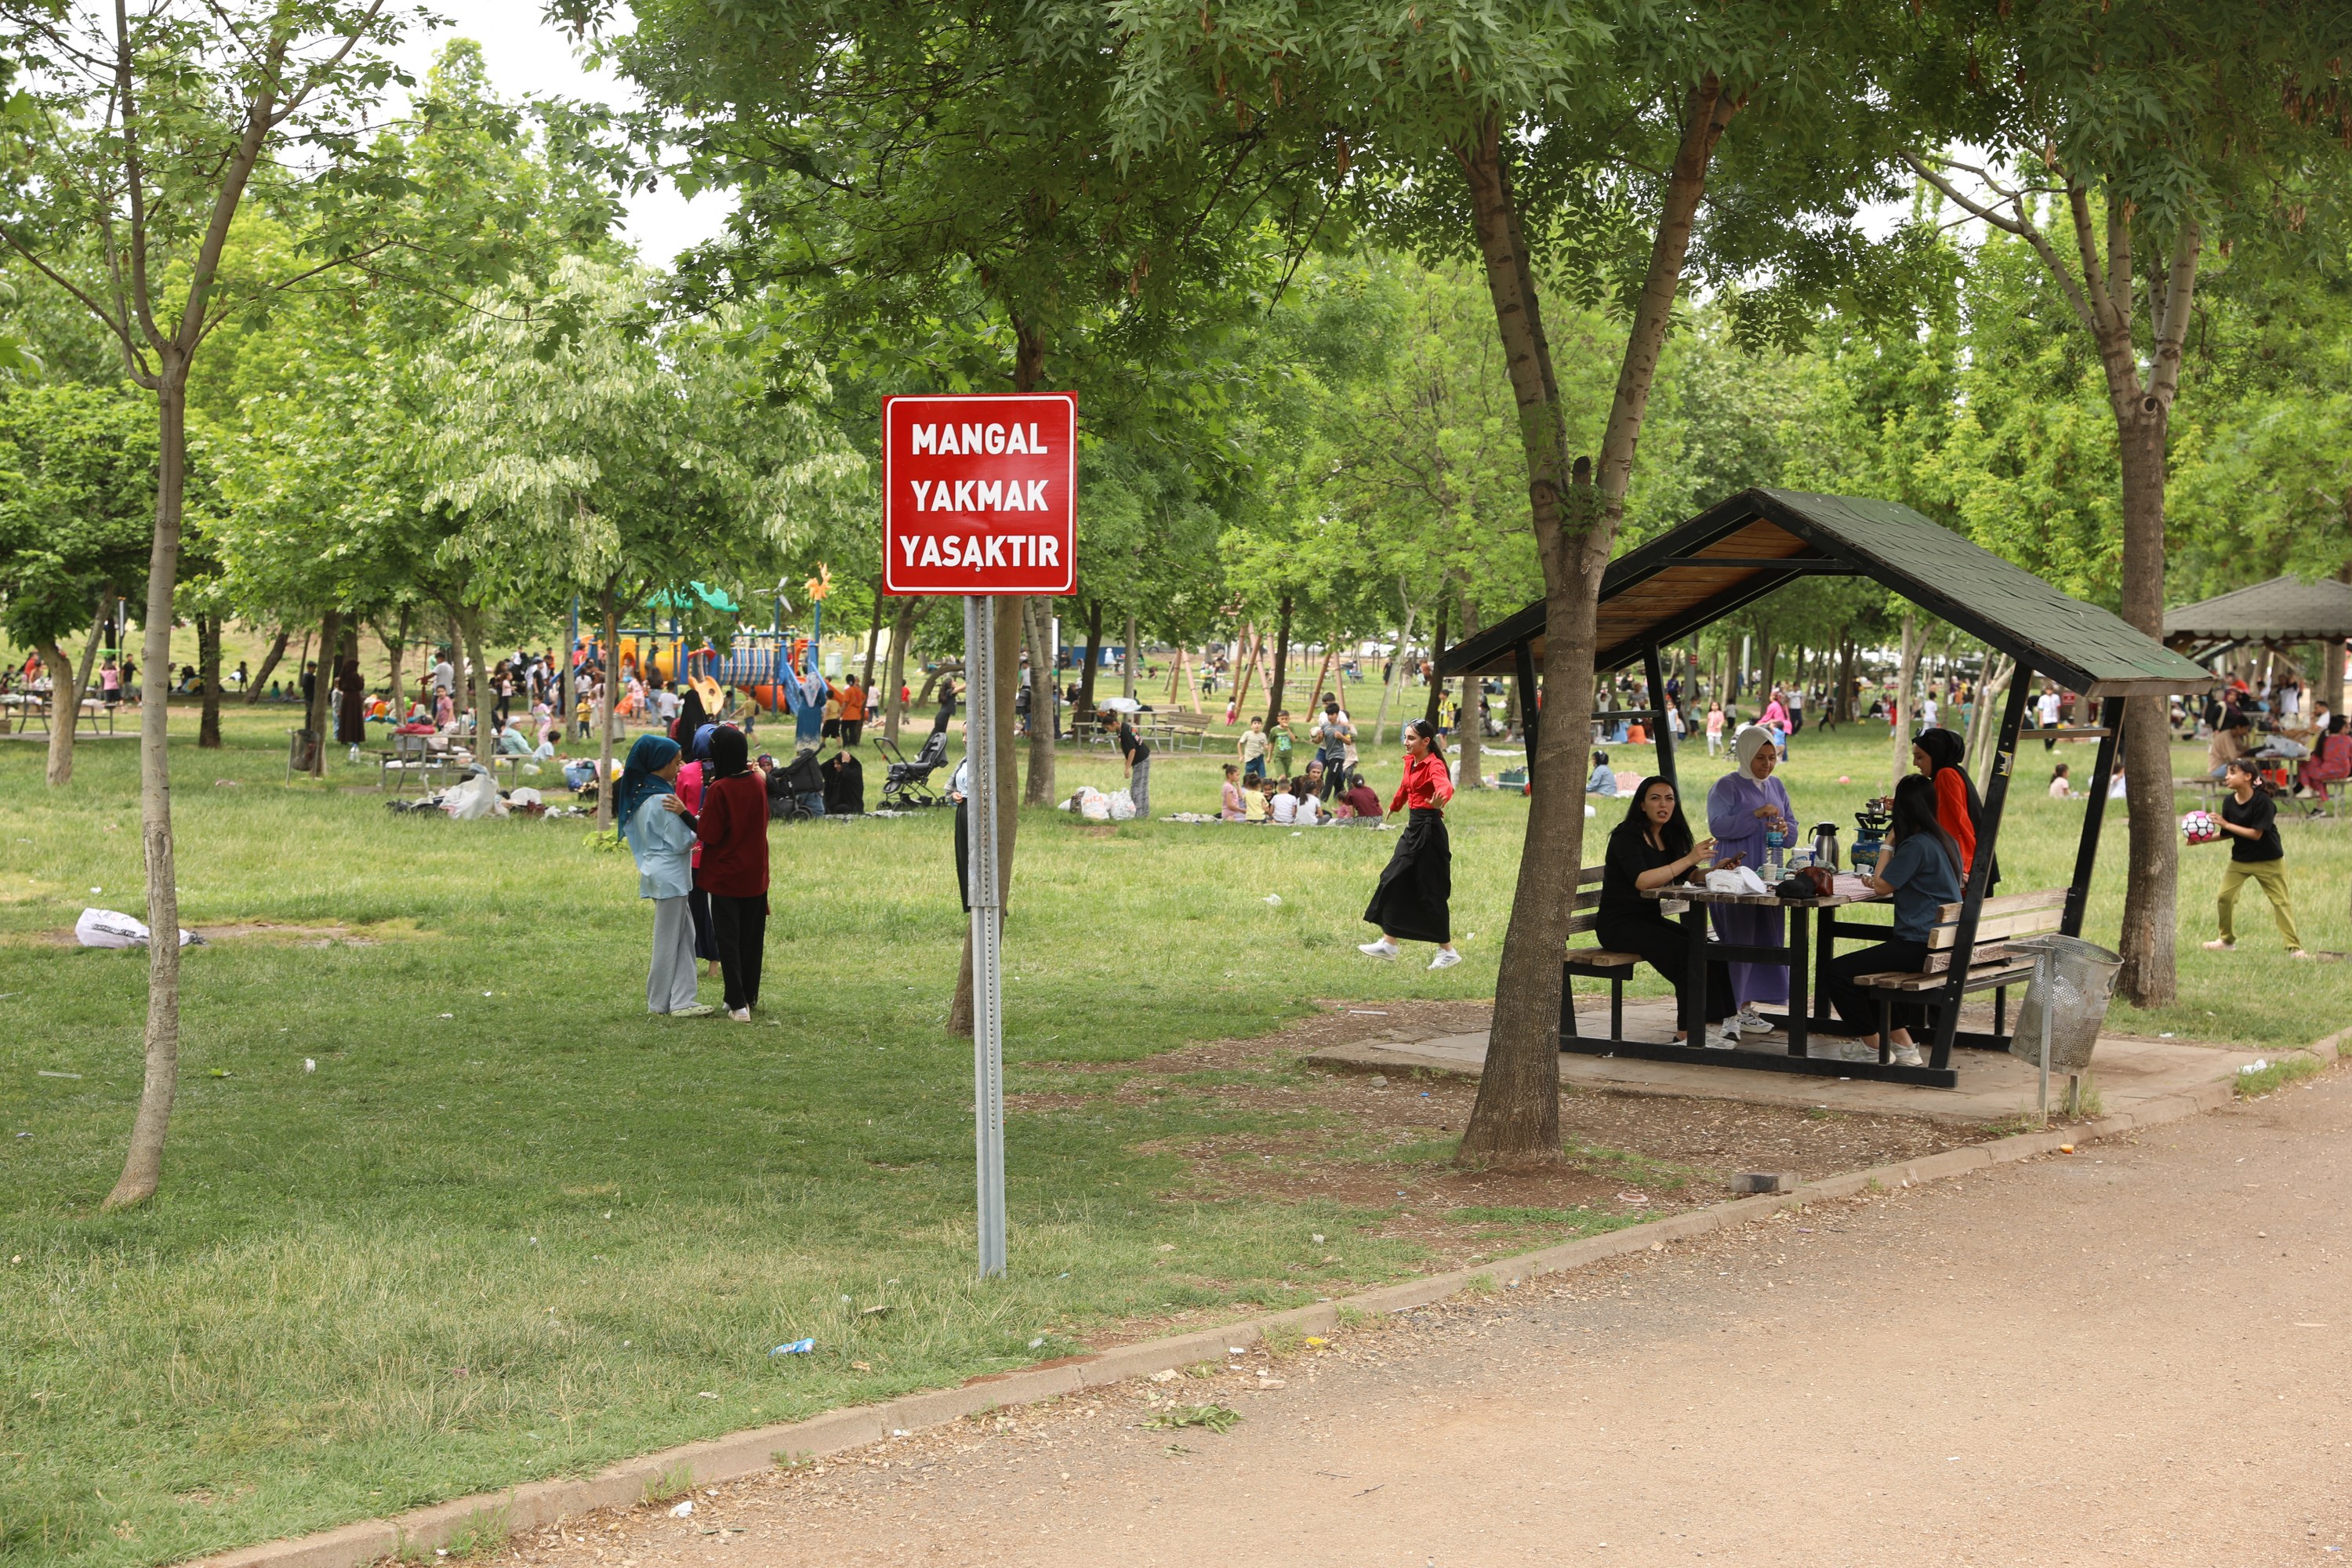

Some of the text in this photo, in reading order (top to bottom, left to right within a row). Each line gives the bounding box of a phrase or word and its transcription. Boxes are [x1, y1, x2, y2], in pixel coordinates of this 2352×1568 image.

[912, 423, 1048, 455] MANGAL
[910, 480, 1049, 512] YAKMAK
[899, 535, 1059, 567] YASAKTIR
